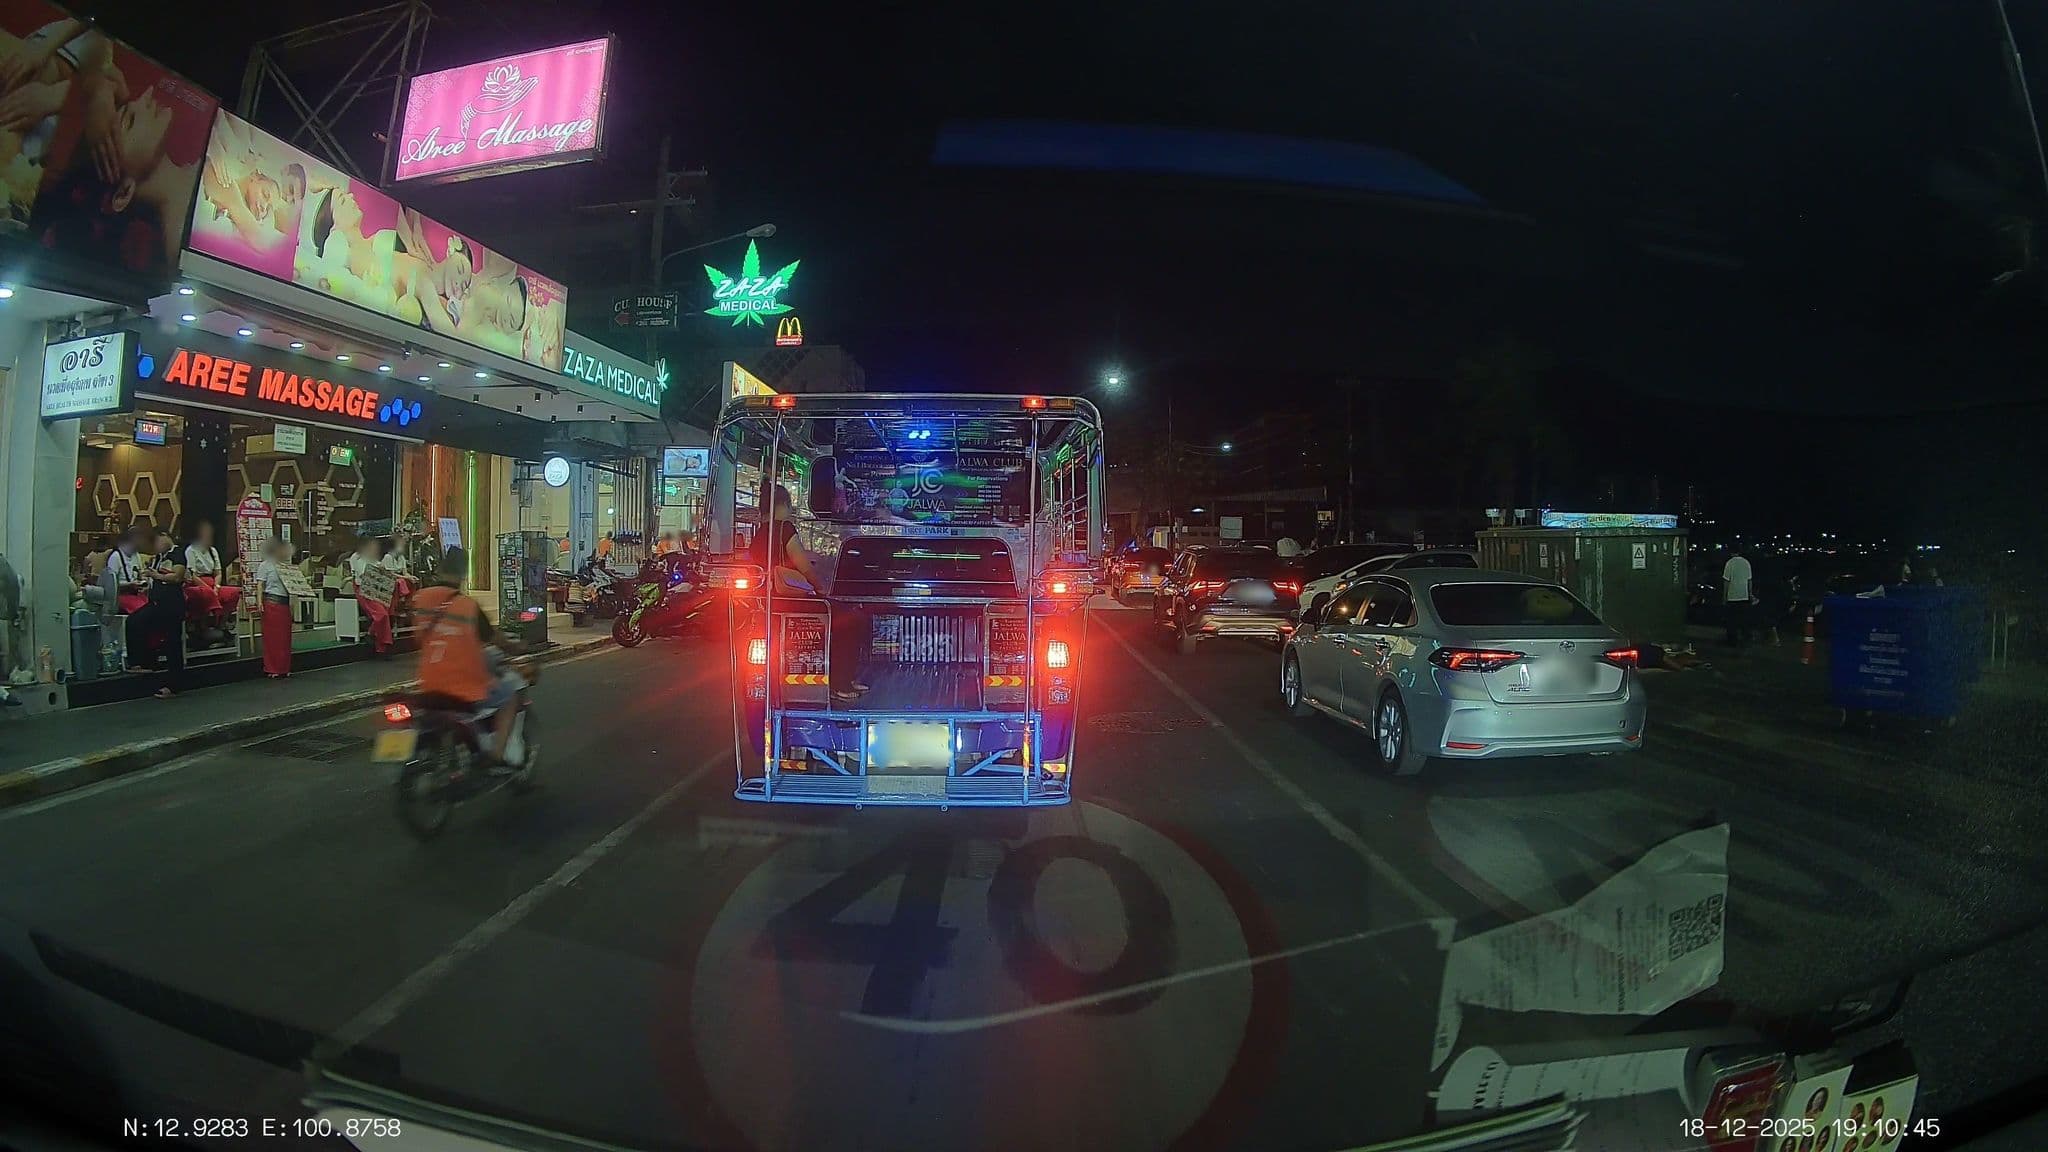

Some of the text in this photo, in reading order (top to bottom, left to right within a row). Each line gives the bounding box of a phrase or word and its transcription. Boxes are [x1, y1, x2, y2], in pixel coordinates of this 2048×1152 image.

[401, 112, 593, 164] Aree Massage
[715, 277, 787, 298] ZAZA
[720, 300, 778, 312] MEDICAL
[563, 347, 659, 405] ZAZA MEDICAL
[164, 349, 379, 420] AREE MASSAGE
[993, 457, 1023, 467] CLUB
[907, 498, 946, 510] JALWA
[789, 631, 821, 640] JALWA
[993, 632, 1026, 641] JALWA
